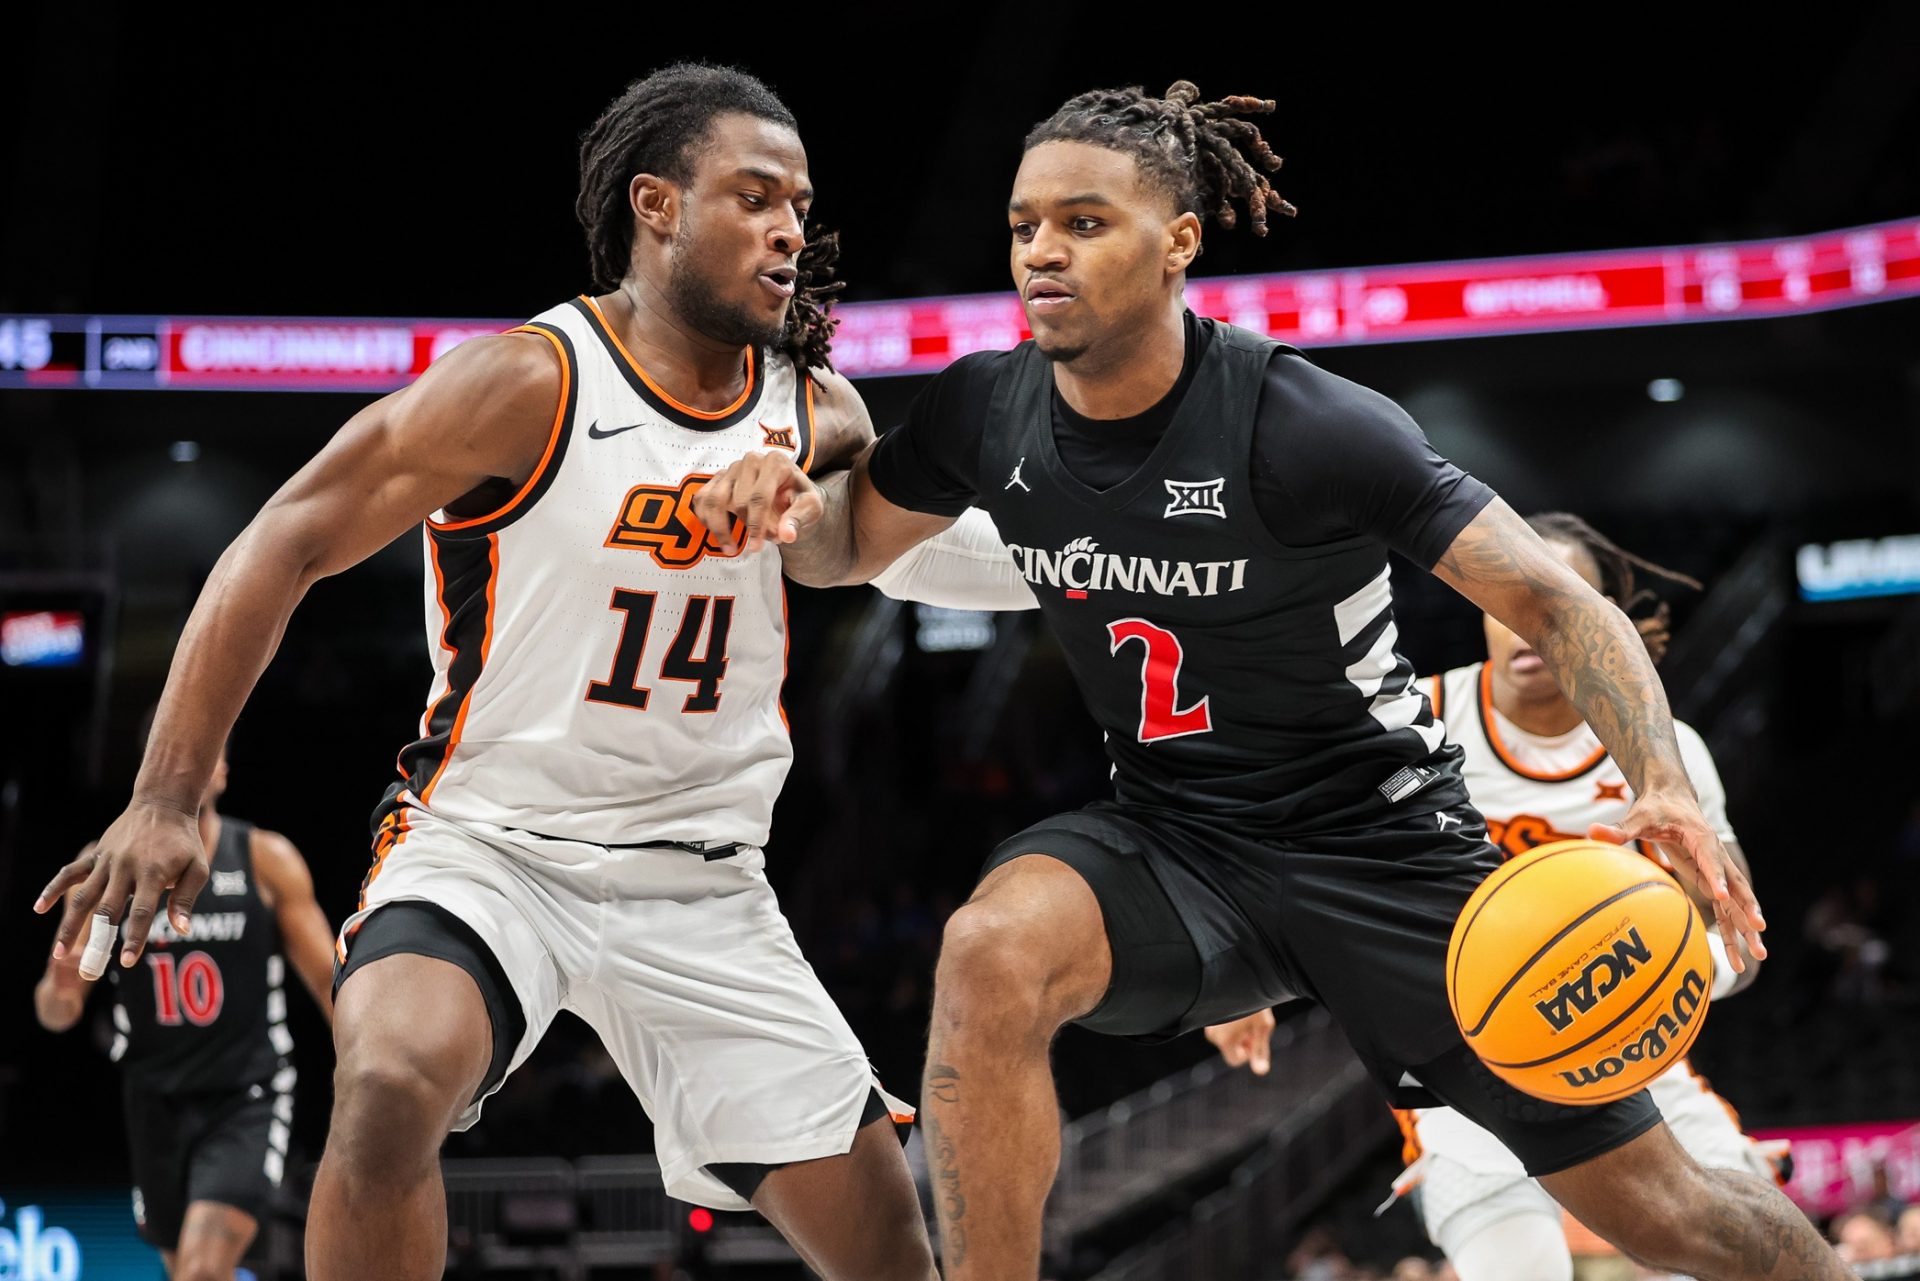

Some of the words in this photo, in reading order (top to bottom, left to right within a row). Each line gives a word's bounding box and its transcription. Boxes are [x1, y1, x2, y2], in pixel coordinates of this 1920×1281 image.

[180, 325, 414, 371] CINCINNATI
[1006, 541, 1249, 597] CINCINNATI
[584, 586, 735, 713] 14
[1106, 617, 1213, 743] 2
[1558, 953, 1589, 979] GAME
[1589, 916, 1631, 951] OFFICIAL
[147, 950, 224, 1027] 10
[1528, 978, 1558, 999] BALL
[1533, 926, 1652, 1032] NCAA
[1560, 968, 1706, 1087] Wilson
